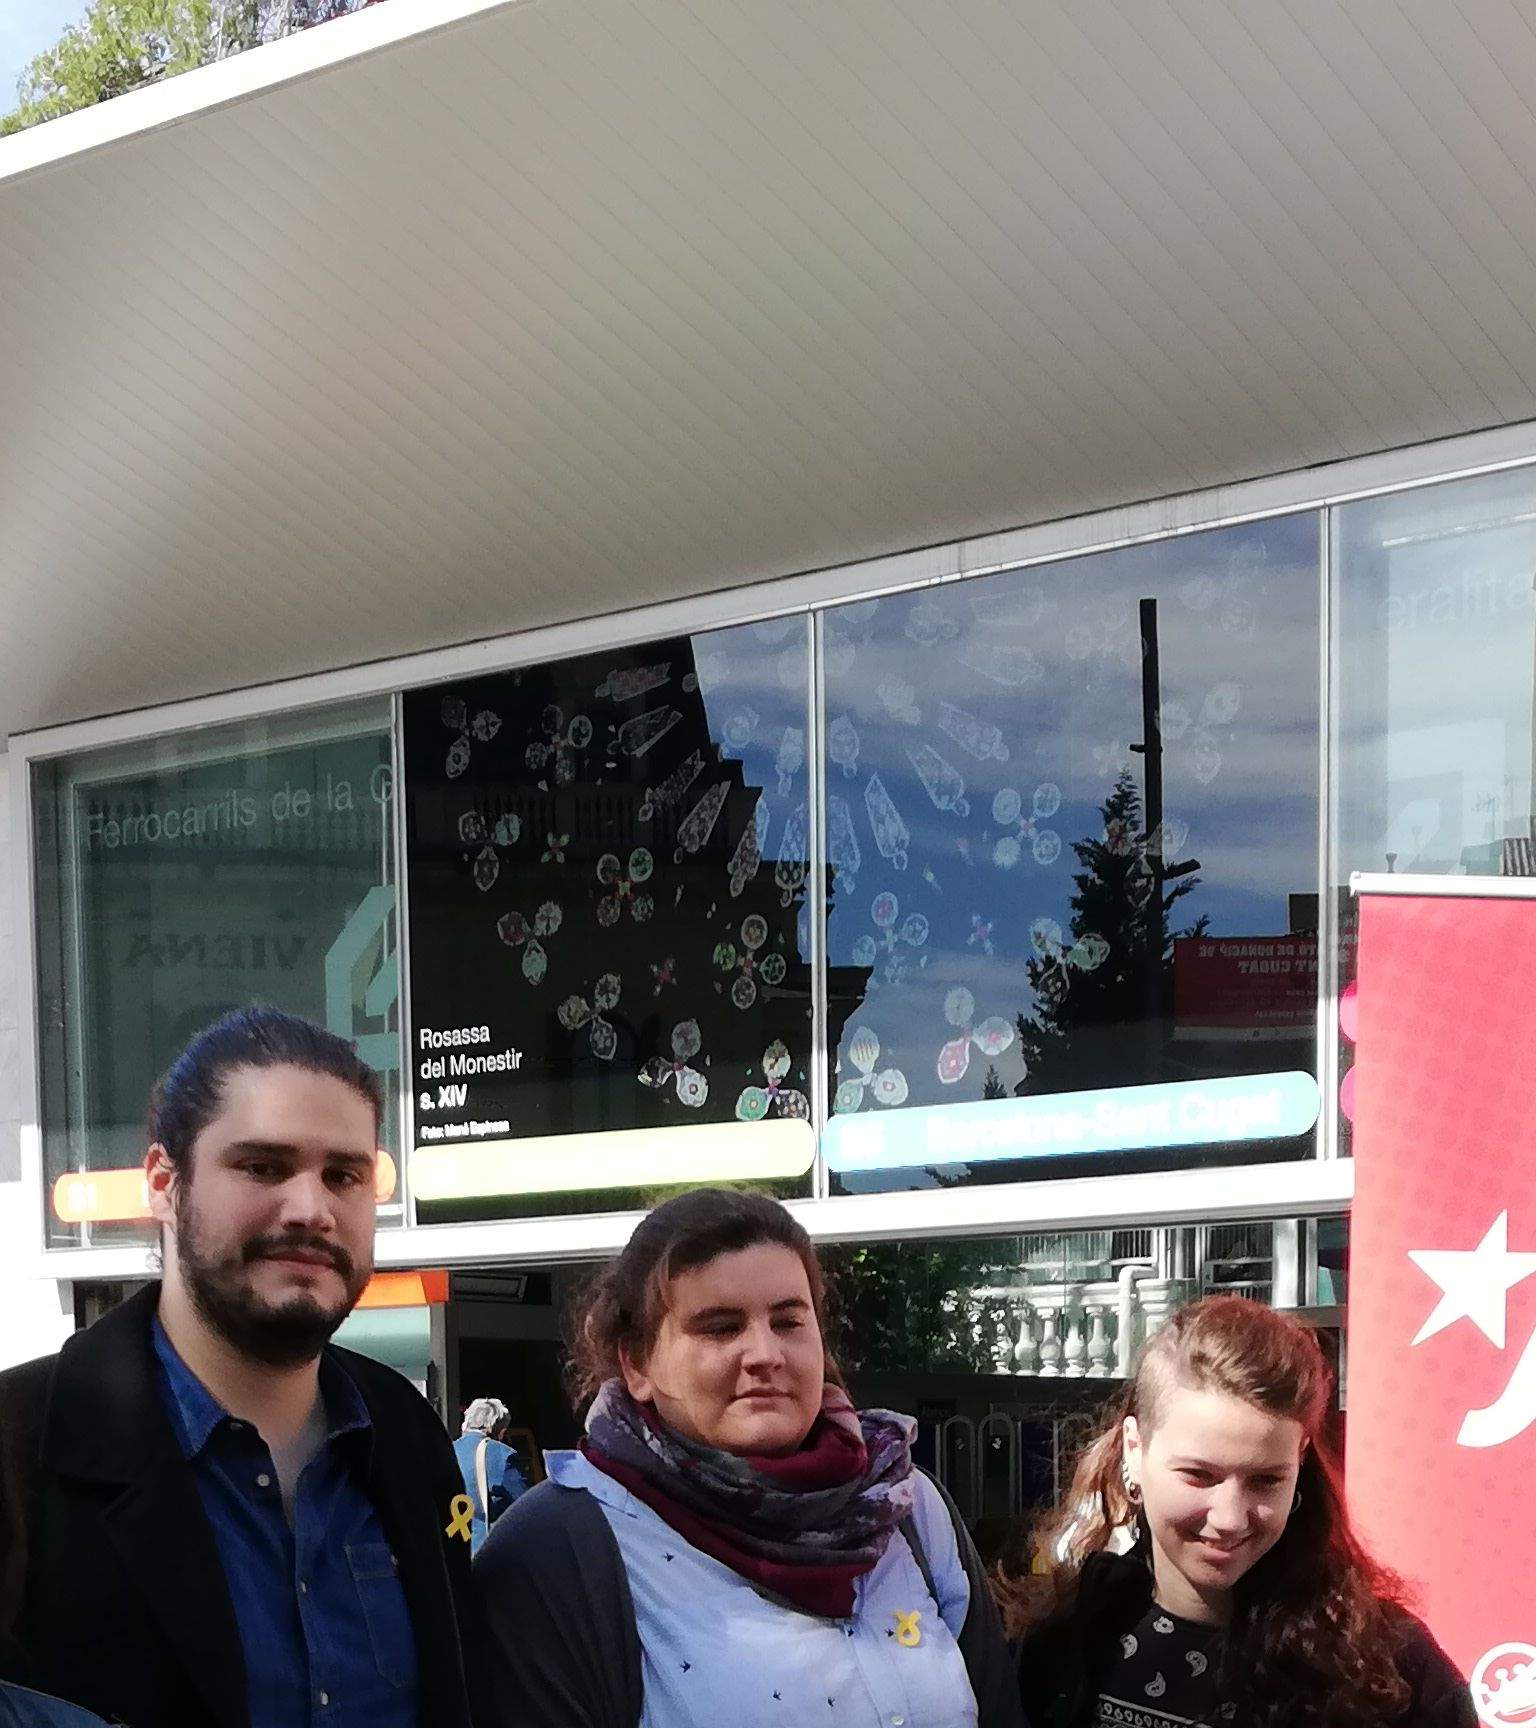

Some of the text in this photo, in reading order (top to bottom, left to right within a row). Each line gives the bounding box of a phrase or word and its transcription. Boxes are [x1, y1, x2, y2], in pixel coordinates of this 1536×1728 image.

[86, 789, 256, 850] Ferrocarrils
[271, 782, 311, 820] de
[327, 774, 353, 811] la
[420, 1026, 491, 1049] Rosassa
[420, 1048, 522, 1079] del Monestir
[438, 1084, 468, 1108] XIV
